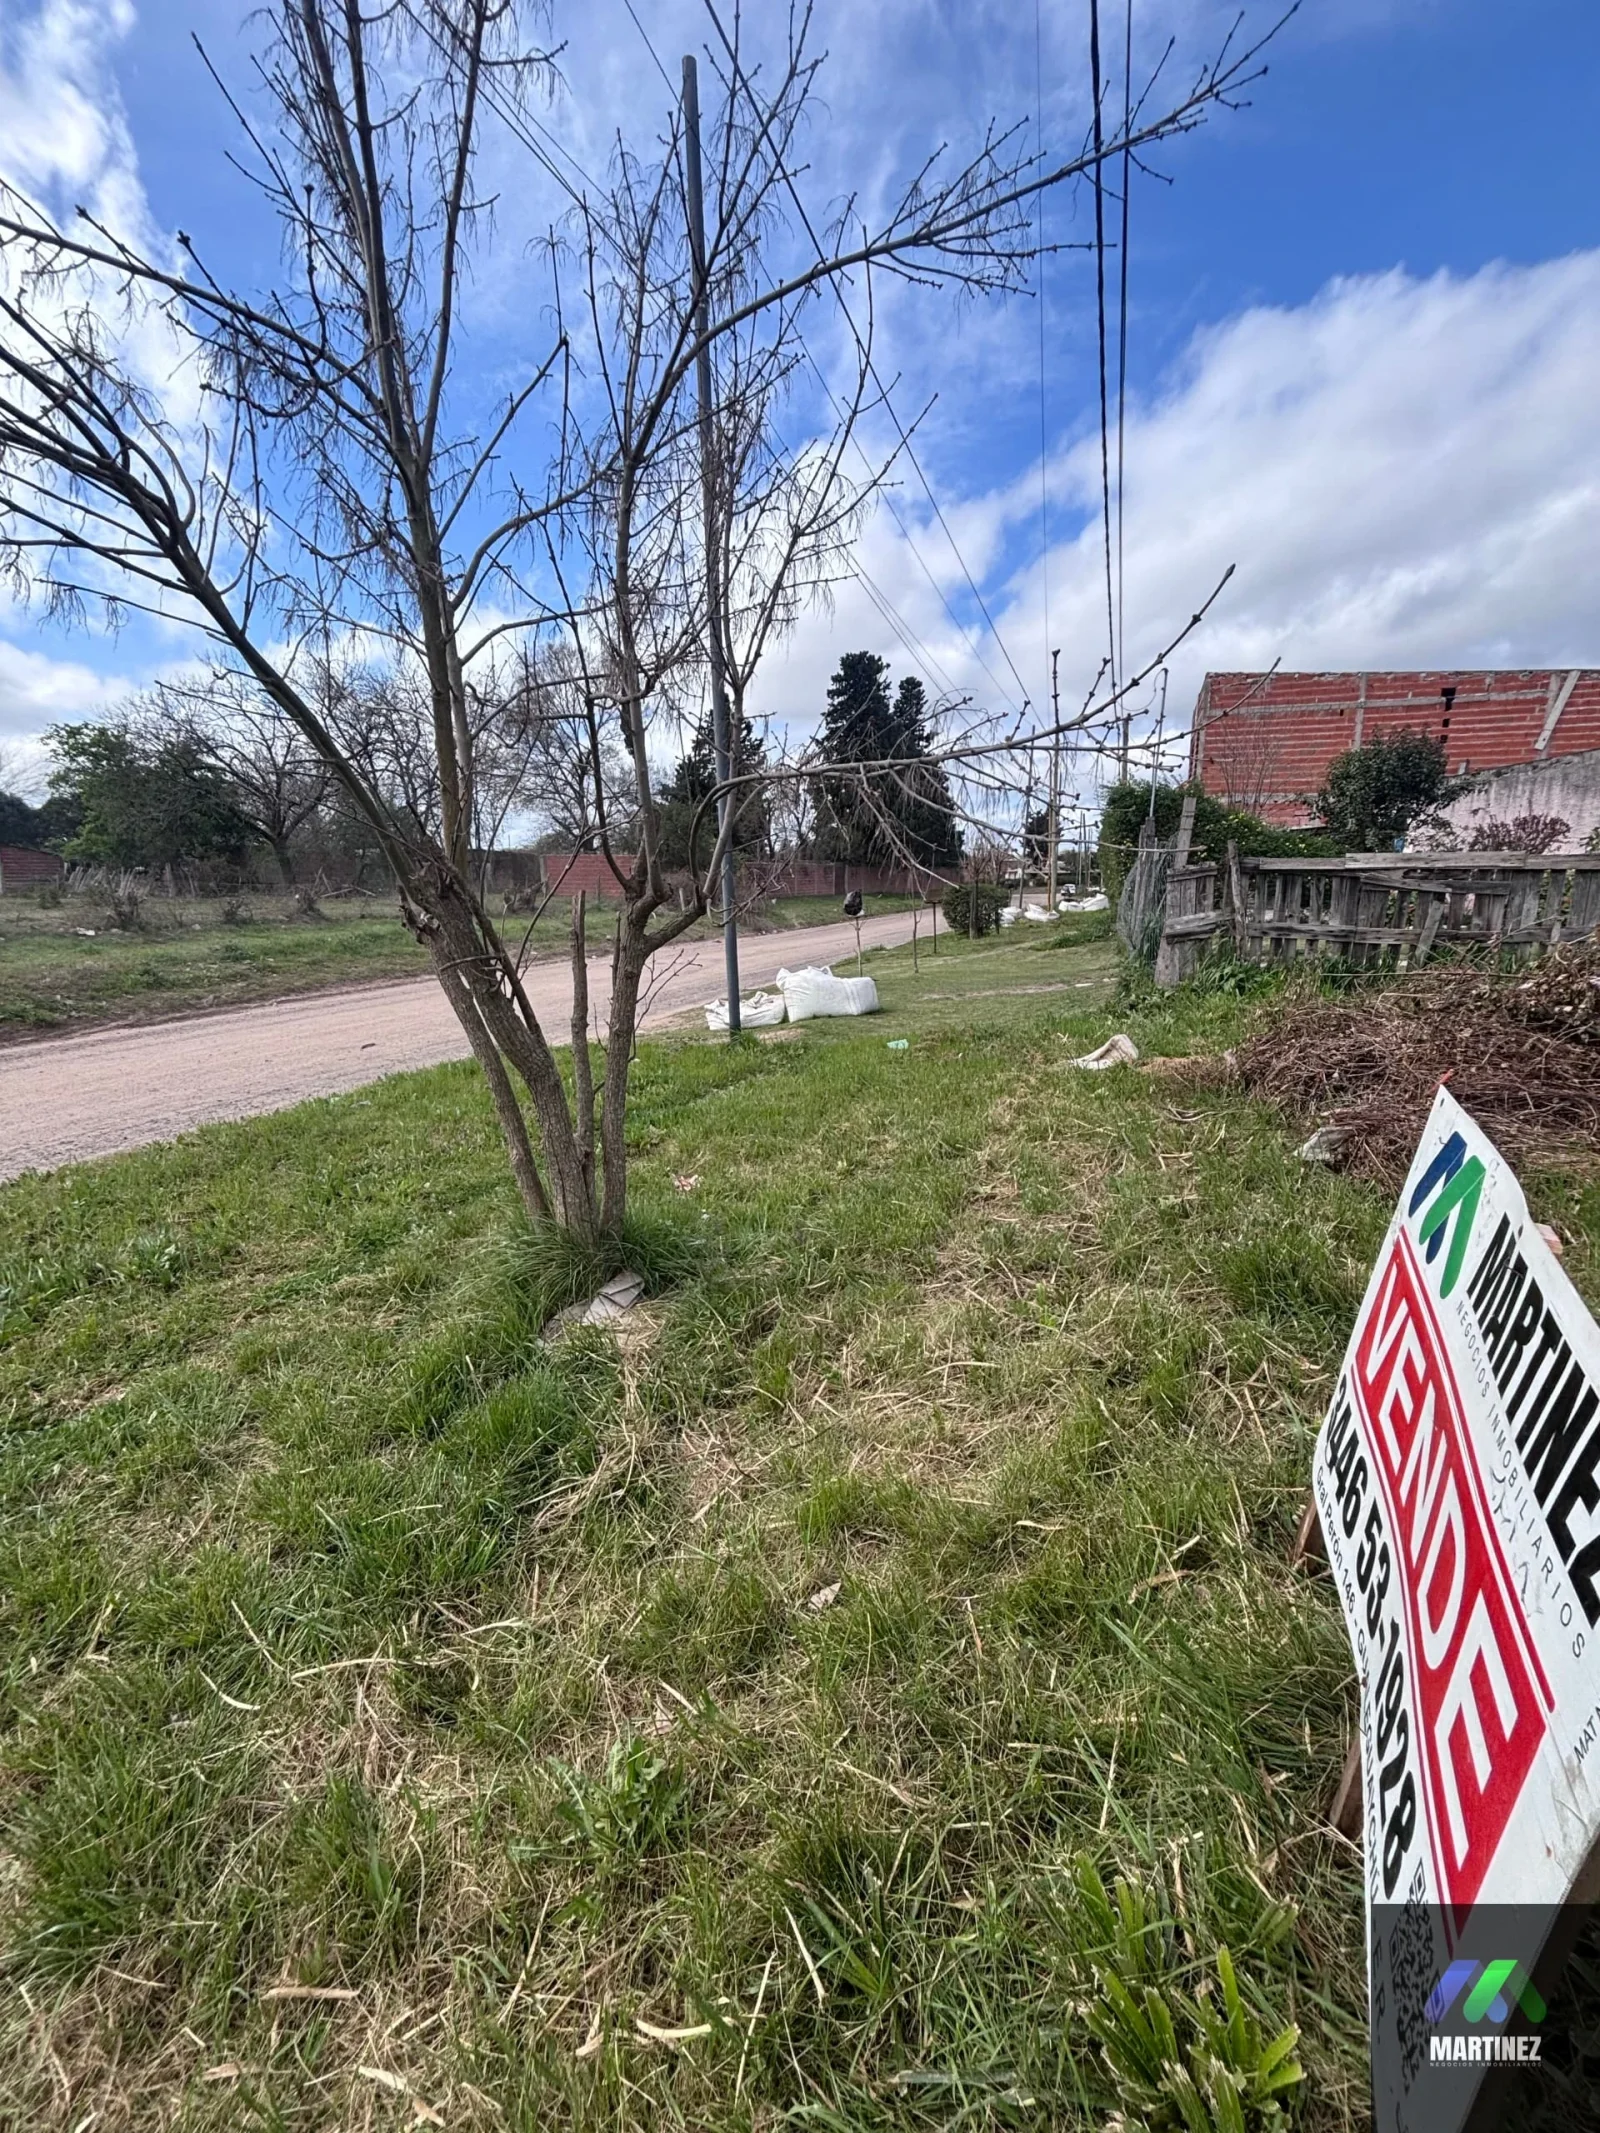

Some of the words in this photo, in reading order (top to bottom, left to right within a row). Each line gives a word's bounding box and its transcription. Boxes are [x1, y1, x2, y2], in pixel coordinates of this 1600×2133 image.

[1325, 1501, 1343, 1570] Perón
[1367, 1258, 1519, 1874] VENDE
[1456, 1300, 1490, 1398] NEGOCIOS
[1487, 1405, 1585, 1659] INMOBILIARIOS
[1467, 1212, 1600, 1630] MARTINE
[1325, 1373, 1368, 1540] 3446
[1357, 1499, 1416, 1900] 53-1928
[1573, 1715, 1598, 1765] MAT
